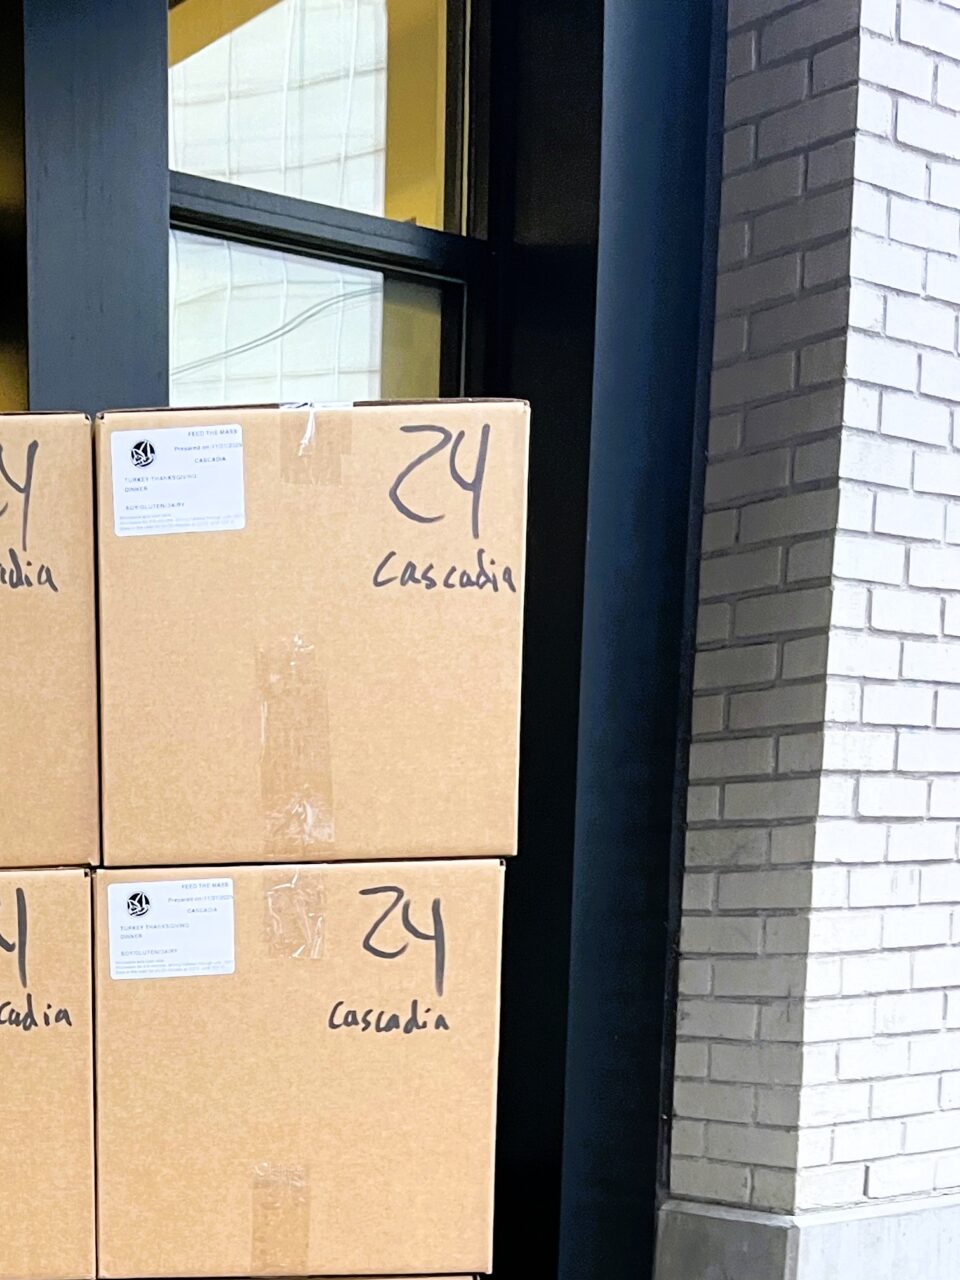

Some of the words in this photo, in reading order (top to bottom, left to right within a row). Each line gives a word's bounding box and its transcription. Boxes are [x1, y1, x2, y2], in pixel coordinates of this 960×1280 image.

[389, 424, 490, 539] 24
[373, 548, 516, 592] Cascadia
[359, 885, 445, 997] 24
[328, 999, 450, 1034] Cascadia
